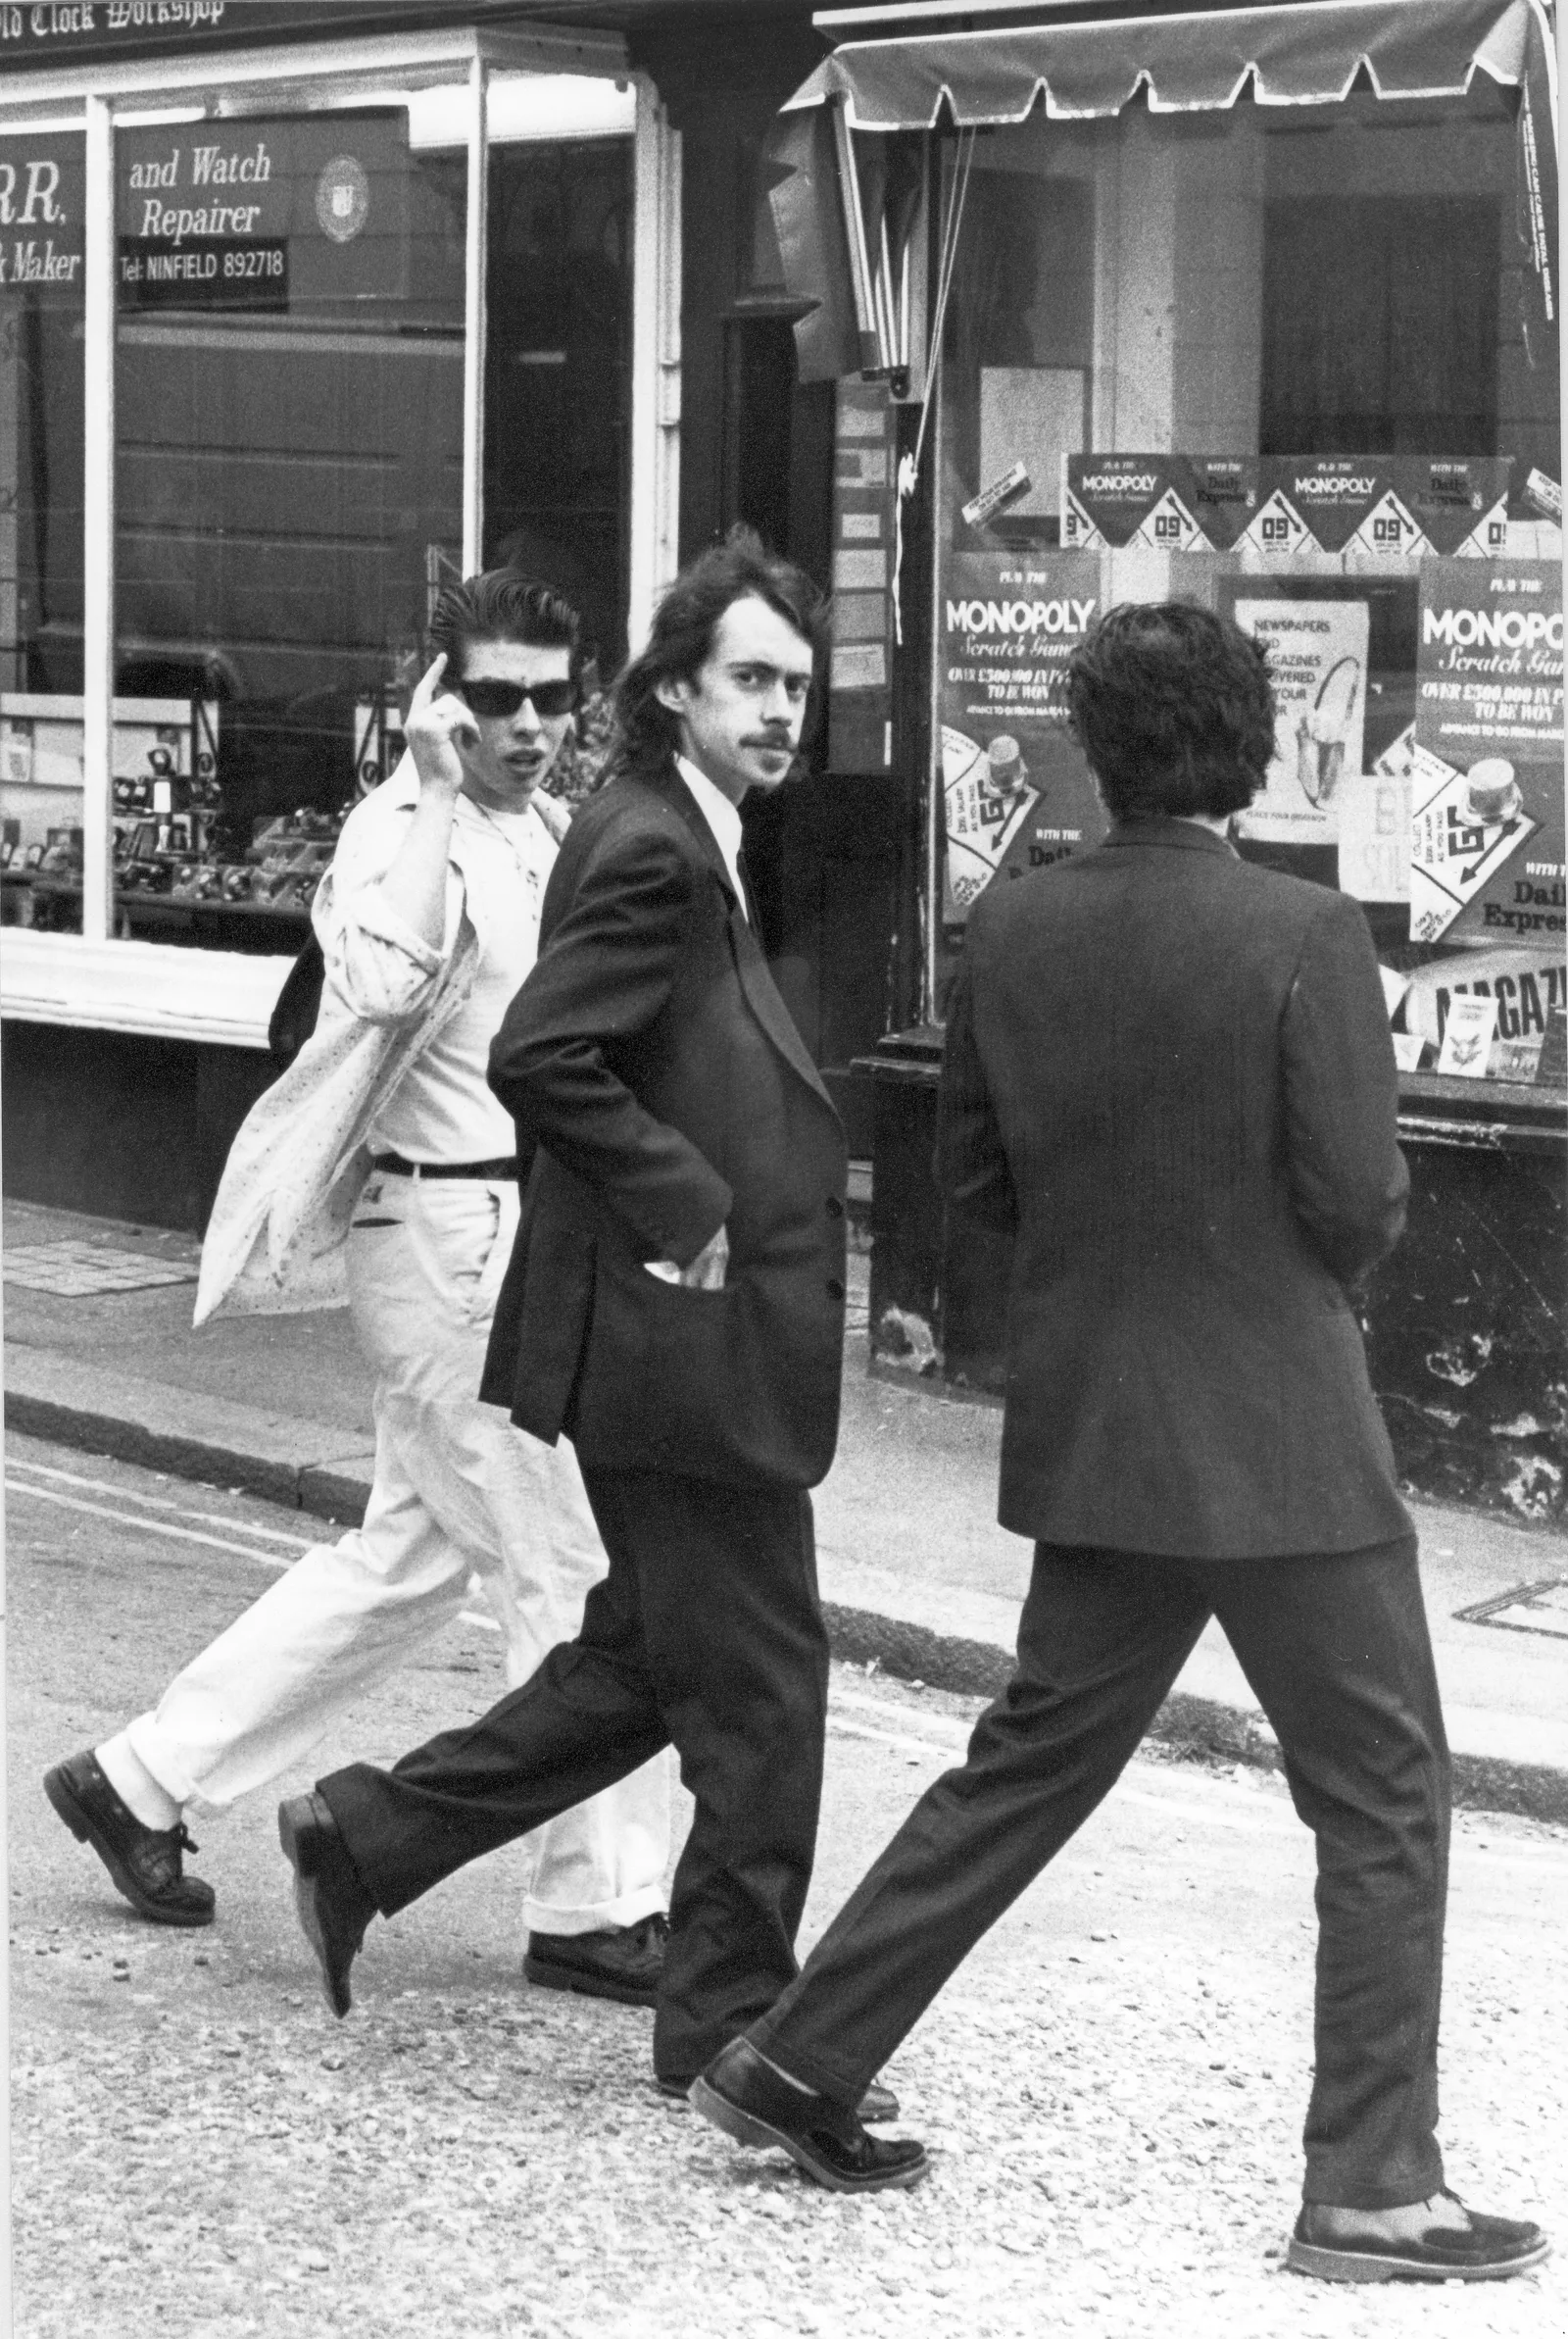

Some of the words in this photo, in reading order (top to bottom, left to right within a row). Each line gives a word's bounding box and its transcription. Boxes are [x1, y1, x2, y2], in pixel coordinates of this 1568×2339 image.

[129, 148, 179, 189] and
[192, 144, 270, 185] Watch
[140, 198, 261, 246] Repairer
[10, 239, 80, 282] Maker
[147, 253, 218, 279] NINFIELD
[223, 250, 283, 277] 892718
[1082, 474, 1157, 491] MONOPOLY
[1295, 476, 1376, 494] MONOPOLY
[946, 598, 1097, 634] MONOPOLY
[1253, 620, 1331, 633] NEWSPAPERS
[960, 634, 1026, 658] Scratch
[1030, 634, 1076, 658] Gam
[1264, 654, 1322, 668] AGAZINES
[1438, 644, 1522, 674] Scratch
[1474, 701, 1495, 719] TO
[1526, 861, 1559, 876] WITH
